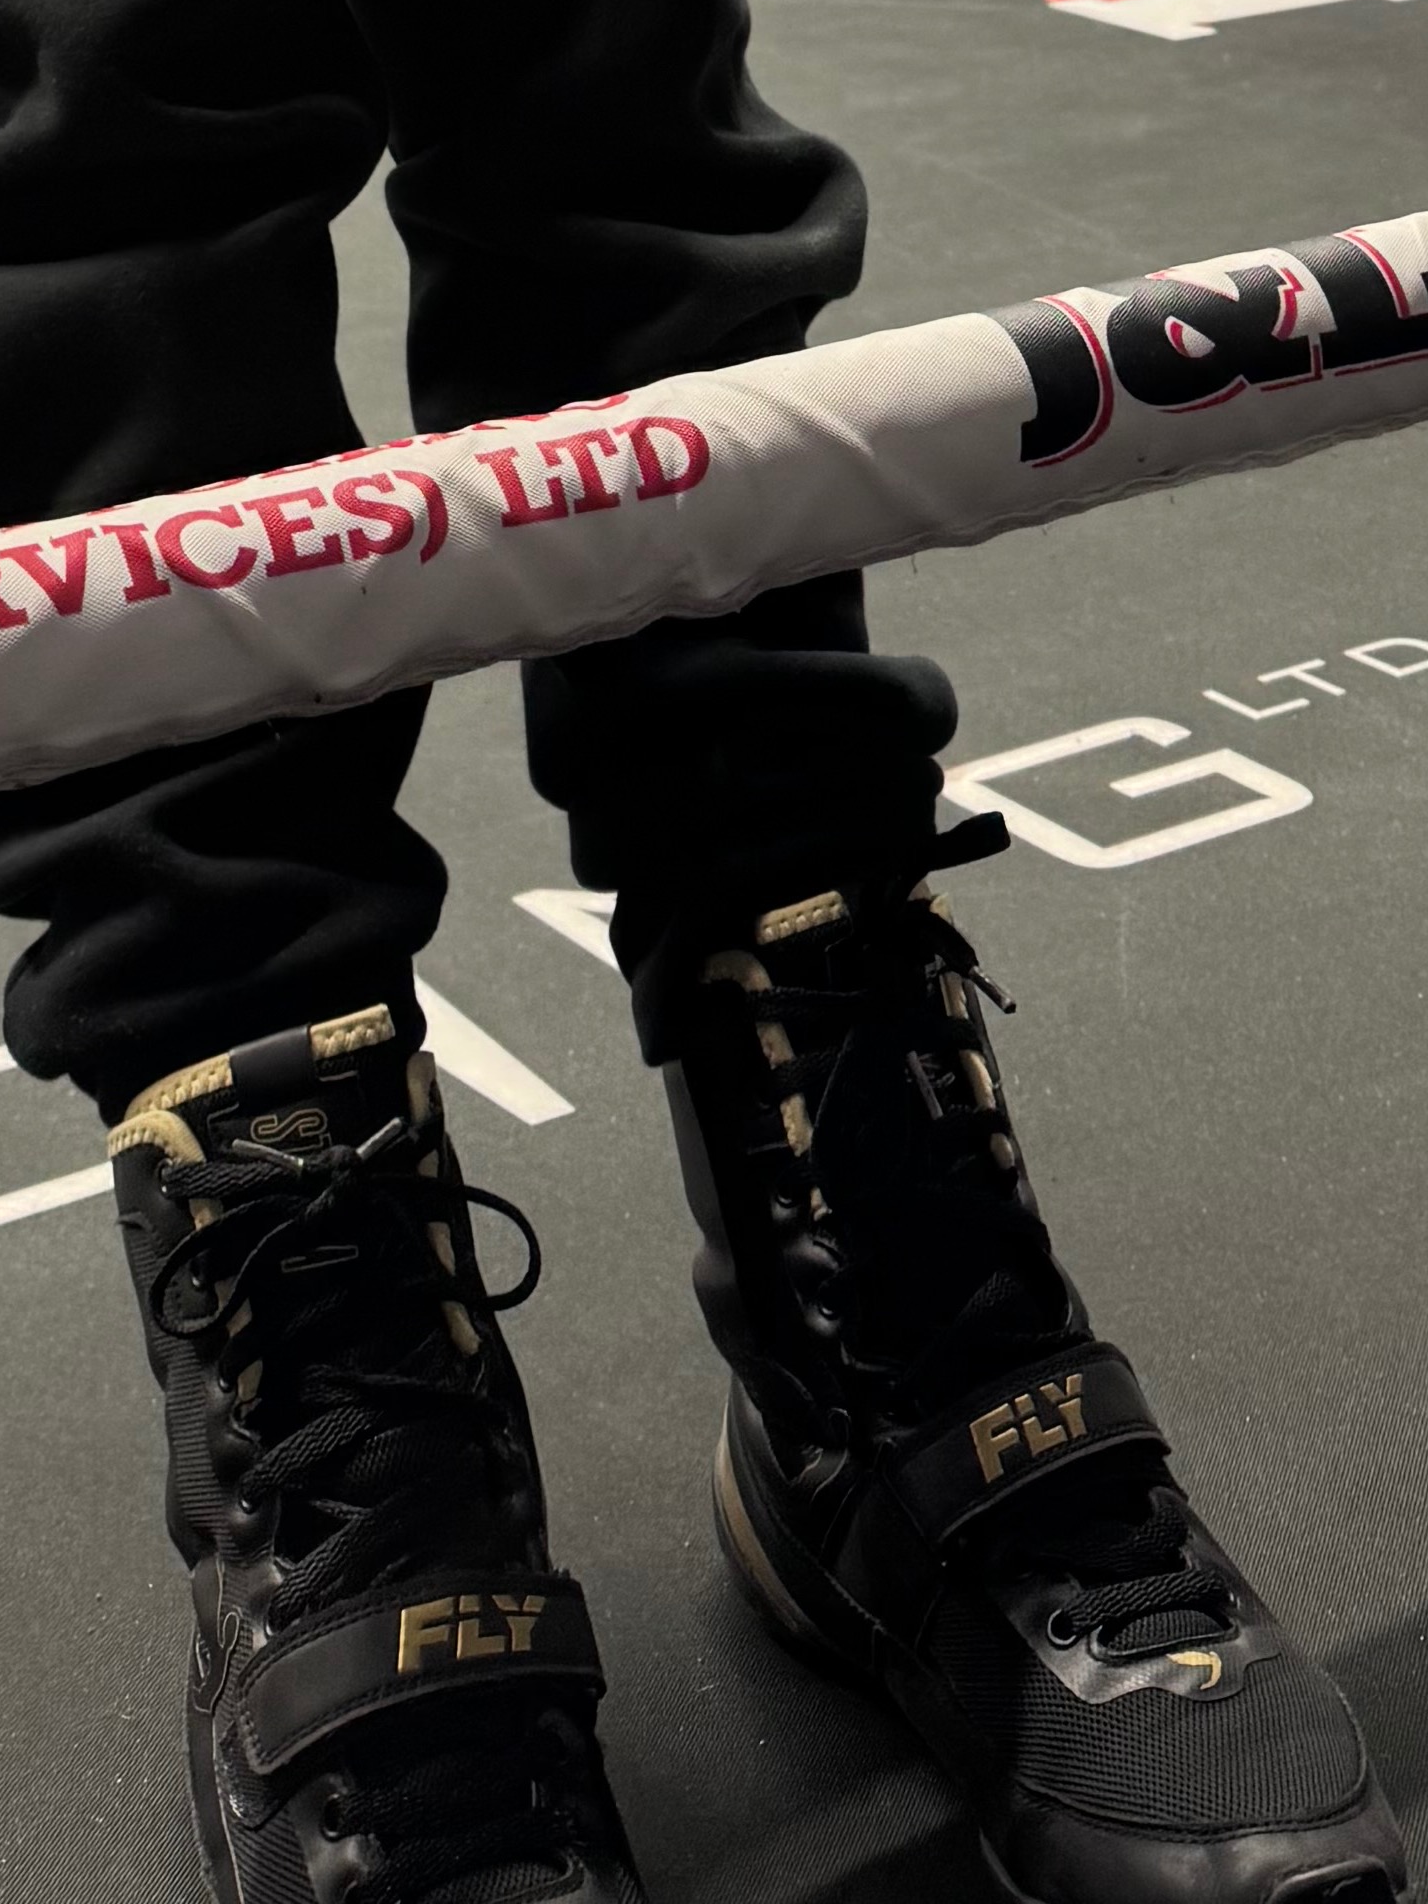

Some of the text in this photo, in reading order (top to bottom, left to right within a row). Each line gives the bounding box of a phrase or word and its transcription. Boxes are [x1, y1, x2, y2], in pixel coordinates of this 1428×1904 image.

[475, 412, 713, 530] LTD
[968, 1372, 1090, 1485] FLY
[396, 1593, 548, 1676] FLY
